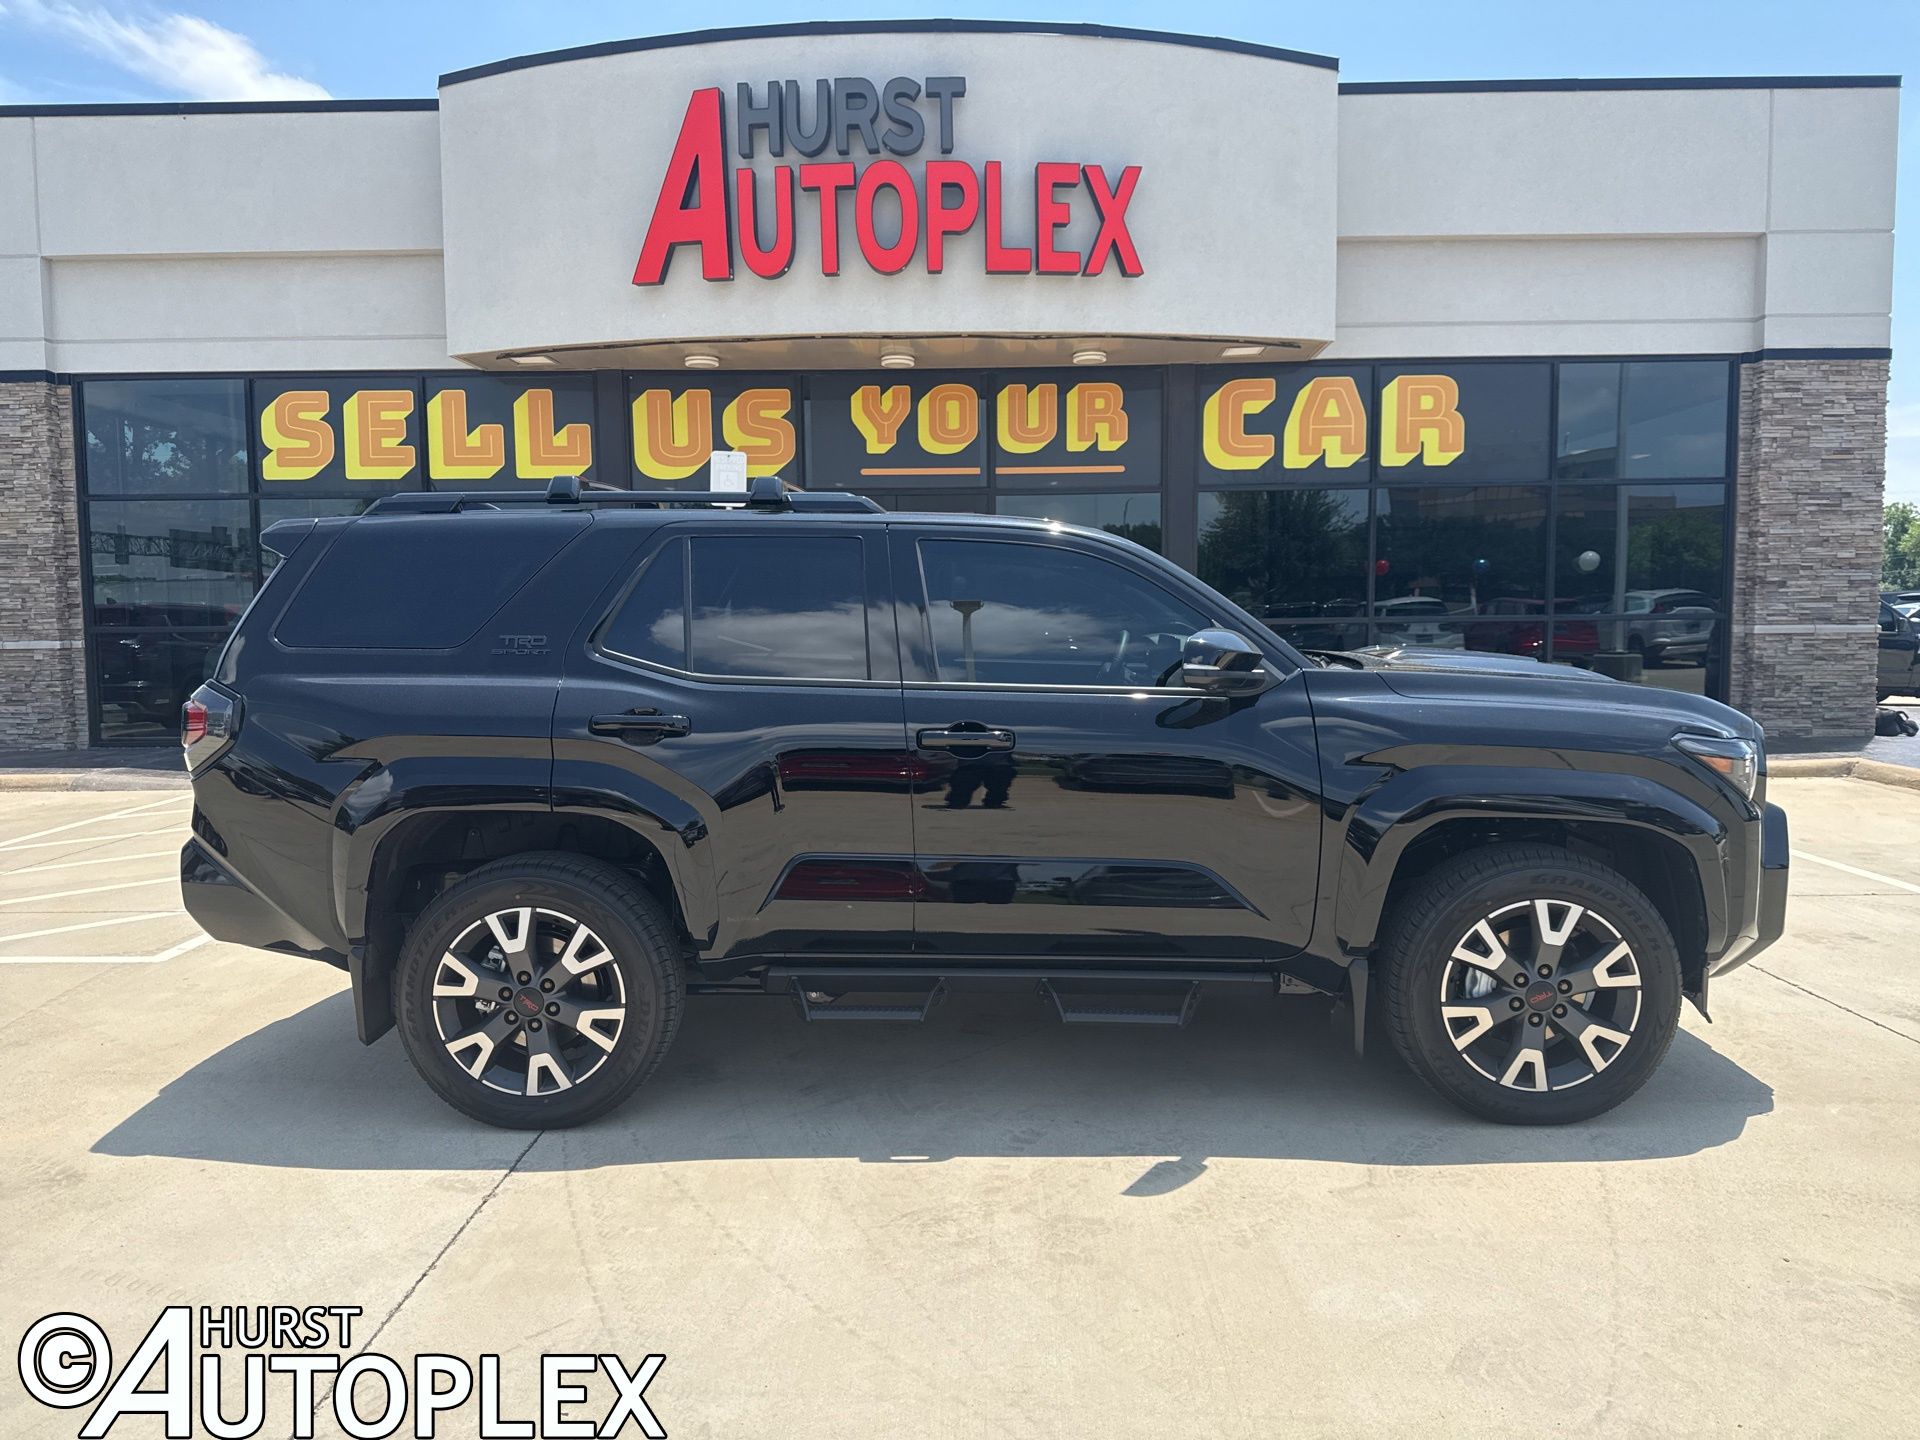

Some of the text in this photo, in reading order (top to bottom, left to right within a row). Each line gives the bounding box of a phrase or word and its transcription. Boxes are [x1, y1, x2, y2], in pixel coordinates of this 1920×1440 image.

[737, 76, 966, 158] HURST
[632, 87, 1144, 286] AUTOPLEX
[261, 374, 1466, 481] SELL US YOUR CAR
[499, 634, 547, 648] TRD
